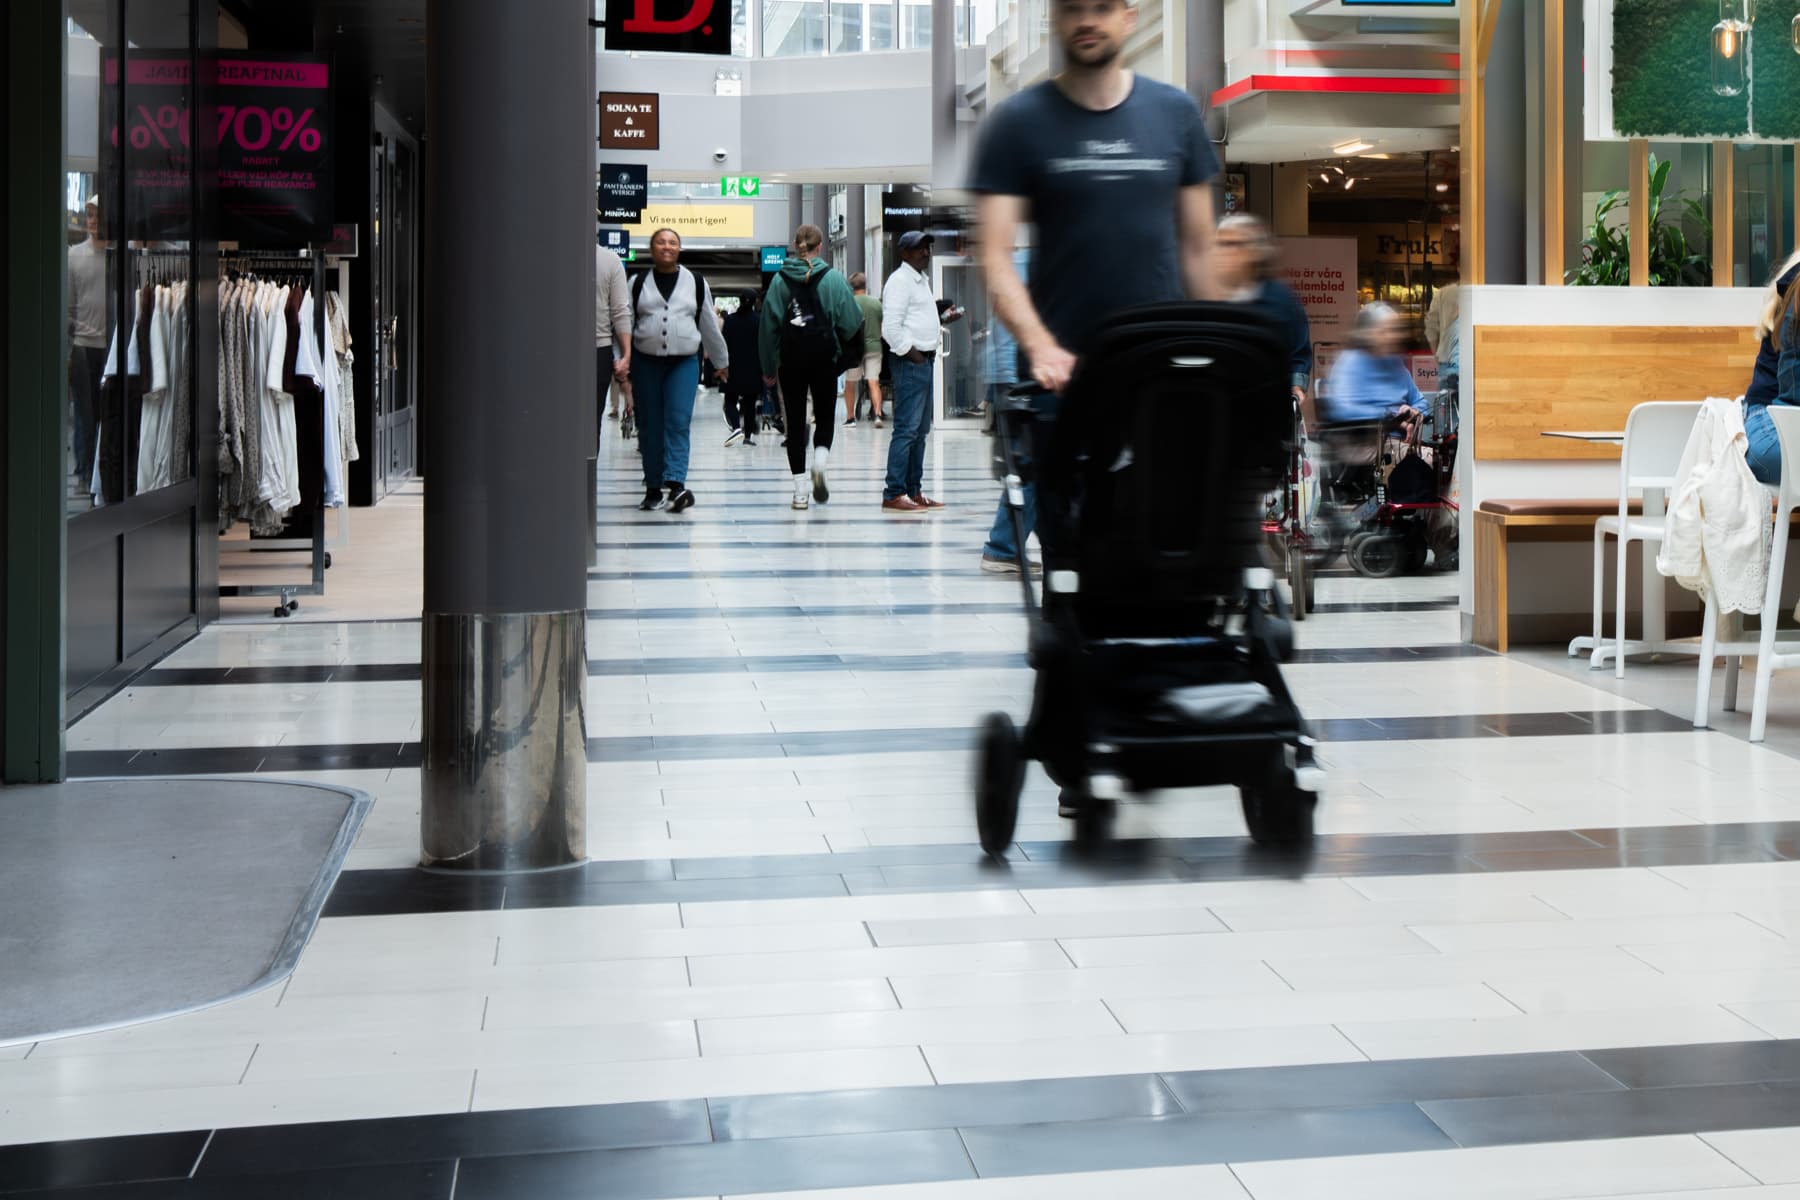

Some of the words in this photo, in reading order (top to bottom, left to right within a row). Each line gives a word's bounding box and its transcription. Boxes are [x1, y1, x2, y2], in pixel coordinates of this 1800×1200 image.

[606, 103, 638, 113] SOLNA
[639, 104, 653, 113] TE
[625, 116, 634, 126] &
[613, 129, 646, 138] KAFFE
[649, 216, 659, 224] Vi
[678, 216, 703, 224] snart
[704, 216, 727, 226] igen!
[1376, 234, 1442, 255] Fruk
[1303, 267, 1314, 278] är
[1318, 266, 1342, 279] våra
